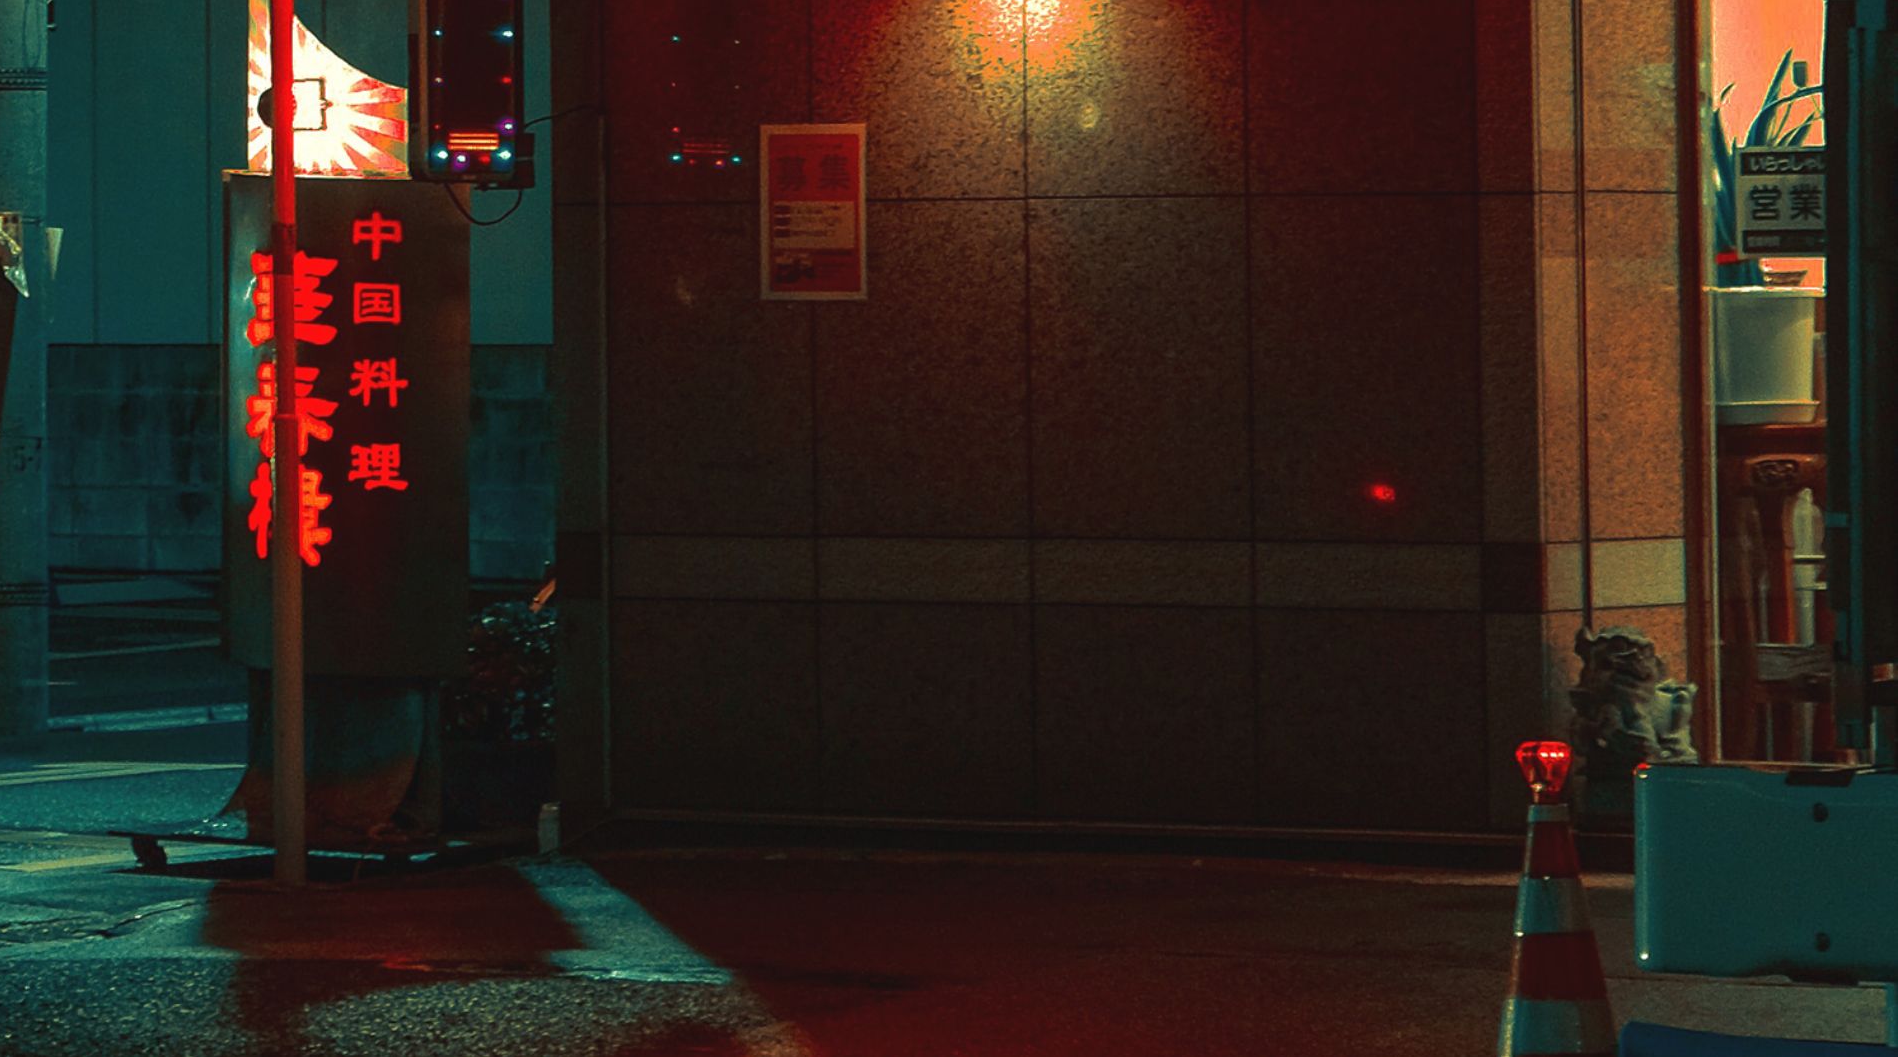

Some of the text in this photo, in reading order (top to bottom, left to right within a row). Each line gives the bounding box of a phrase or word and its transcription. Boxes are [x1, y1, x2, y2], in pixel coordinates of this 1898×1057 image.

[1750, 184, 1822, 220] 営業
[348, 211, 408, 491] 中国料理
